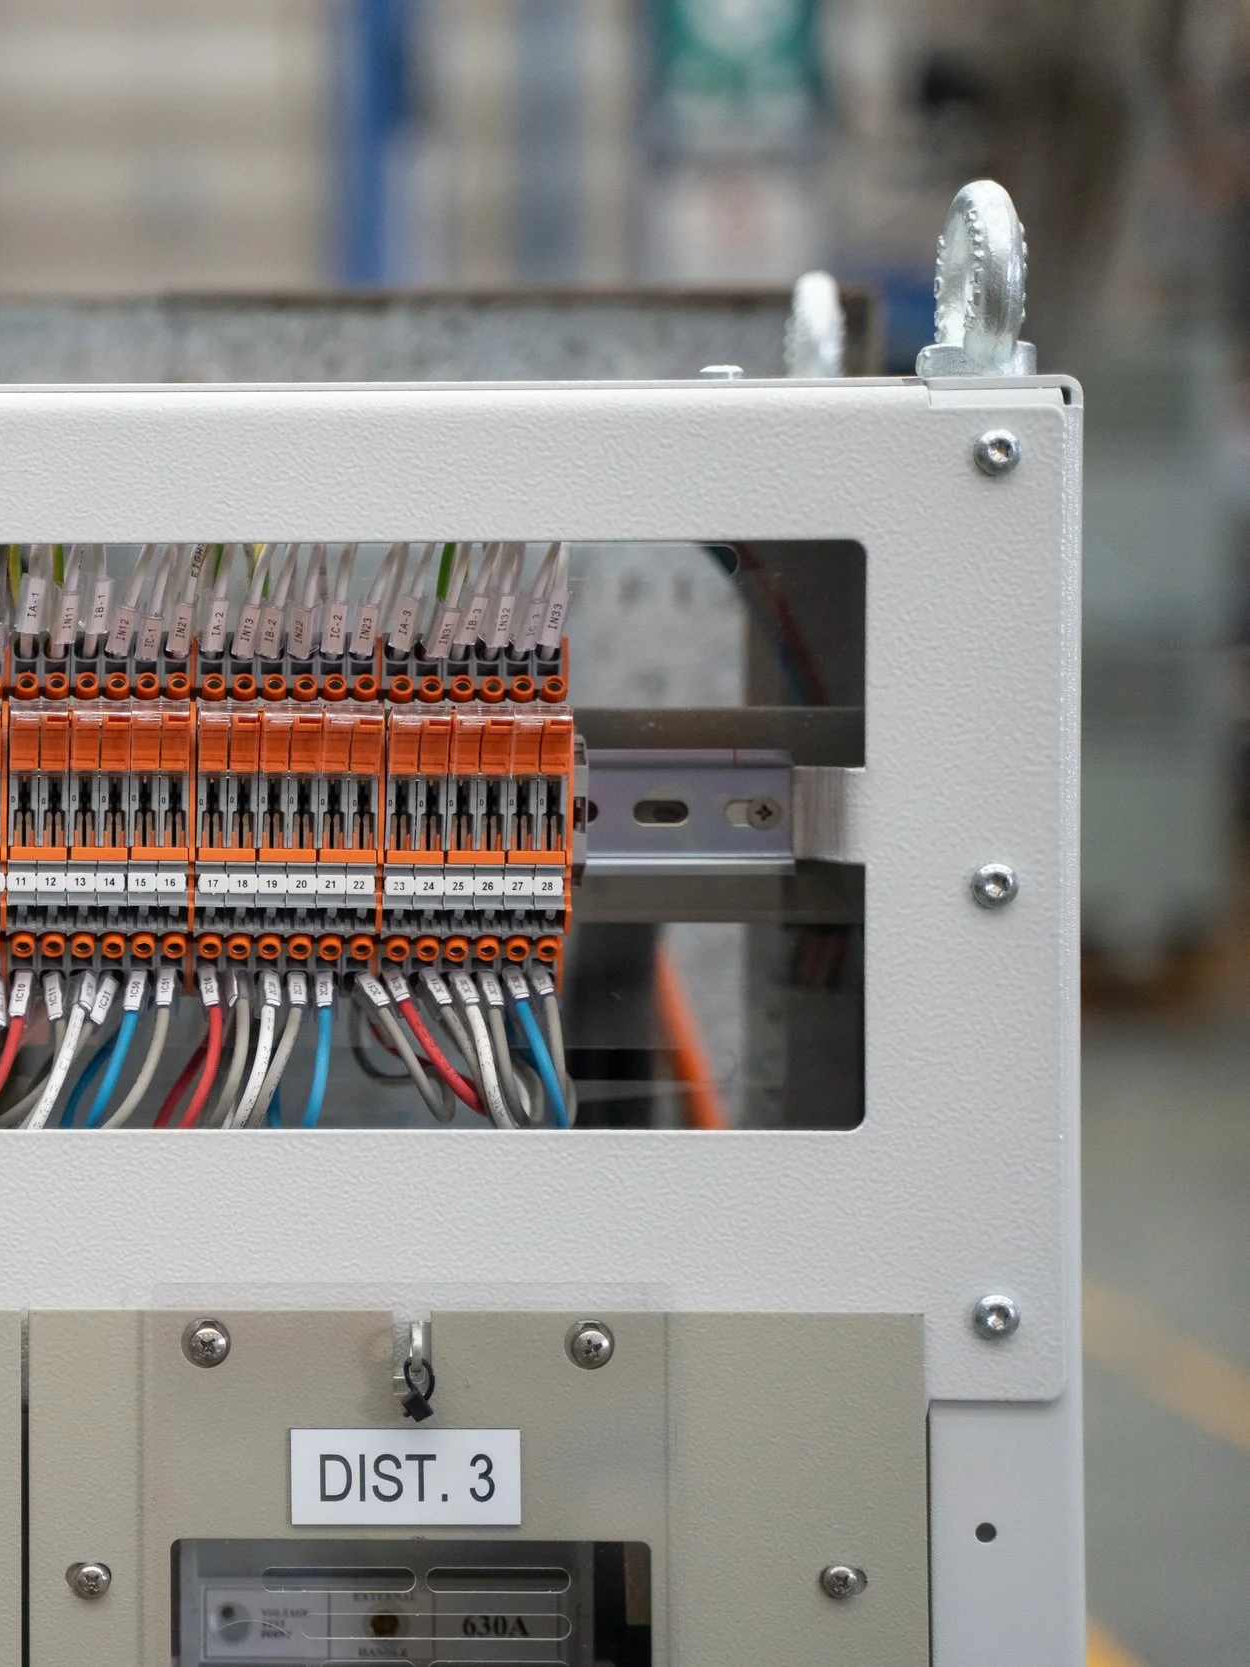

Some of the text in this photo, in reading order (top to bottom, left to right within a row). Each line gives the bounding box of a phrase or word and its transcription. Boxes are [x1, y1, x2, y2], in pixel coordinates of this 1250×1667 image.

[16, 877, 26, 886] 11
[45, 877, 56, 886] 12
[75, 878, 86, 886] 13
[104, 878, 115, 886] 14
[135, 878, 146, 887] 15
[165, 878, 176, 887] 16
[296, 880, 307, 888] 20
[353, 881, 365, 889] 22
[394, 882, 405, 891] 23
[423, 882, 434, 890] 24
[452, 882, 464, 890] 25
[482, 882, 493, 890] 26
[512, 882, 523, 890] 27
[541, 882, 553, 890] 28
[320, 1454, 495, 1502] DIST. 3
[462, 1615, 530, 1638] 630A
